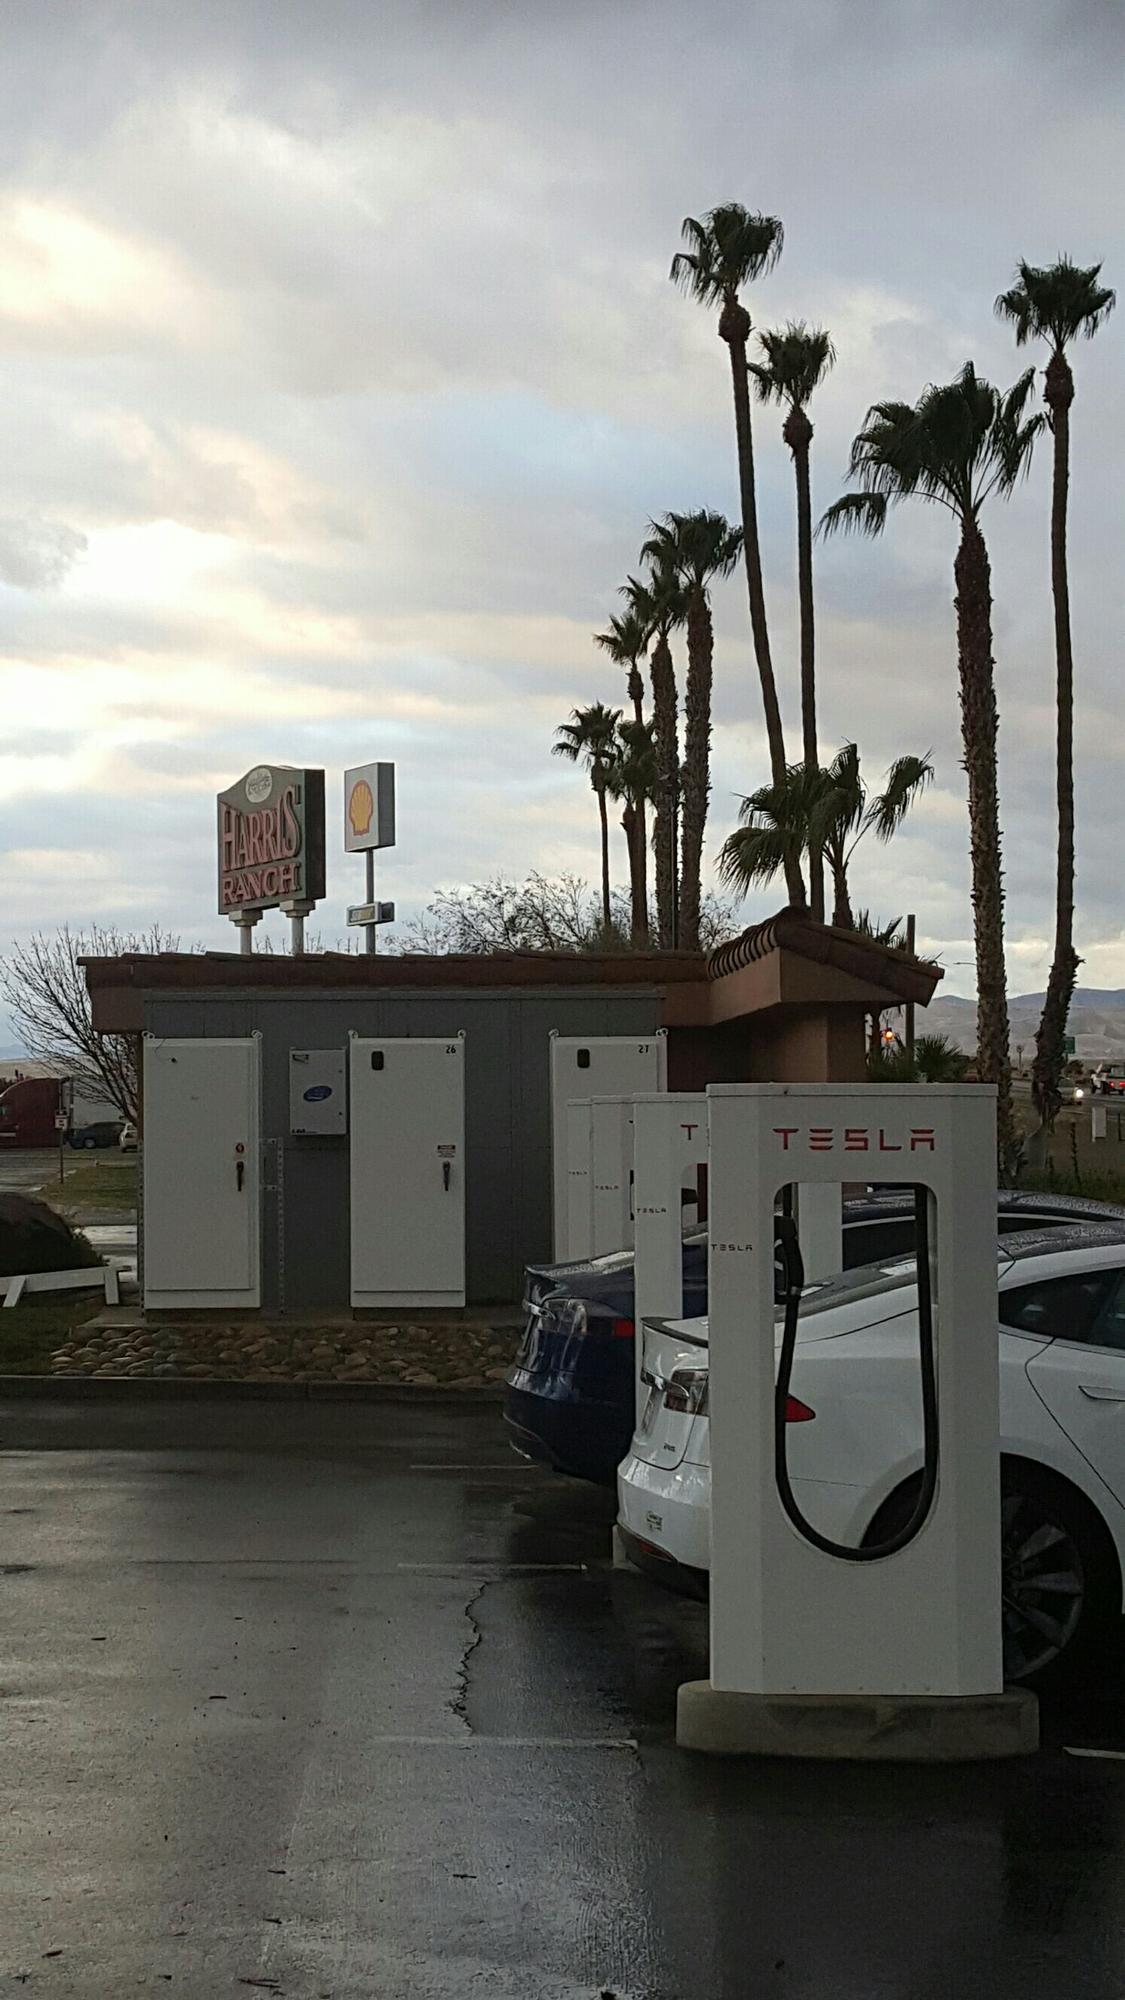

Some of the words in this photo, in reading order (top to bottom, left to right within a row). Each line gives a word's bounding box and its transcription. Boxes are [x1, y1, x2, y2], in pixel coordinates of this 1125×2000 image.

[220, 785, 302, 872] HARRIS
[221, 863, 302, 905] RANCH
[445, 1045, 456, 1054] 26
[772, 1128, 935, 1151] TESLA
[711, 1244, 753, 1252] TESLA
